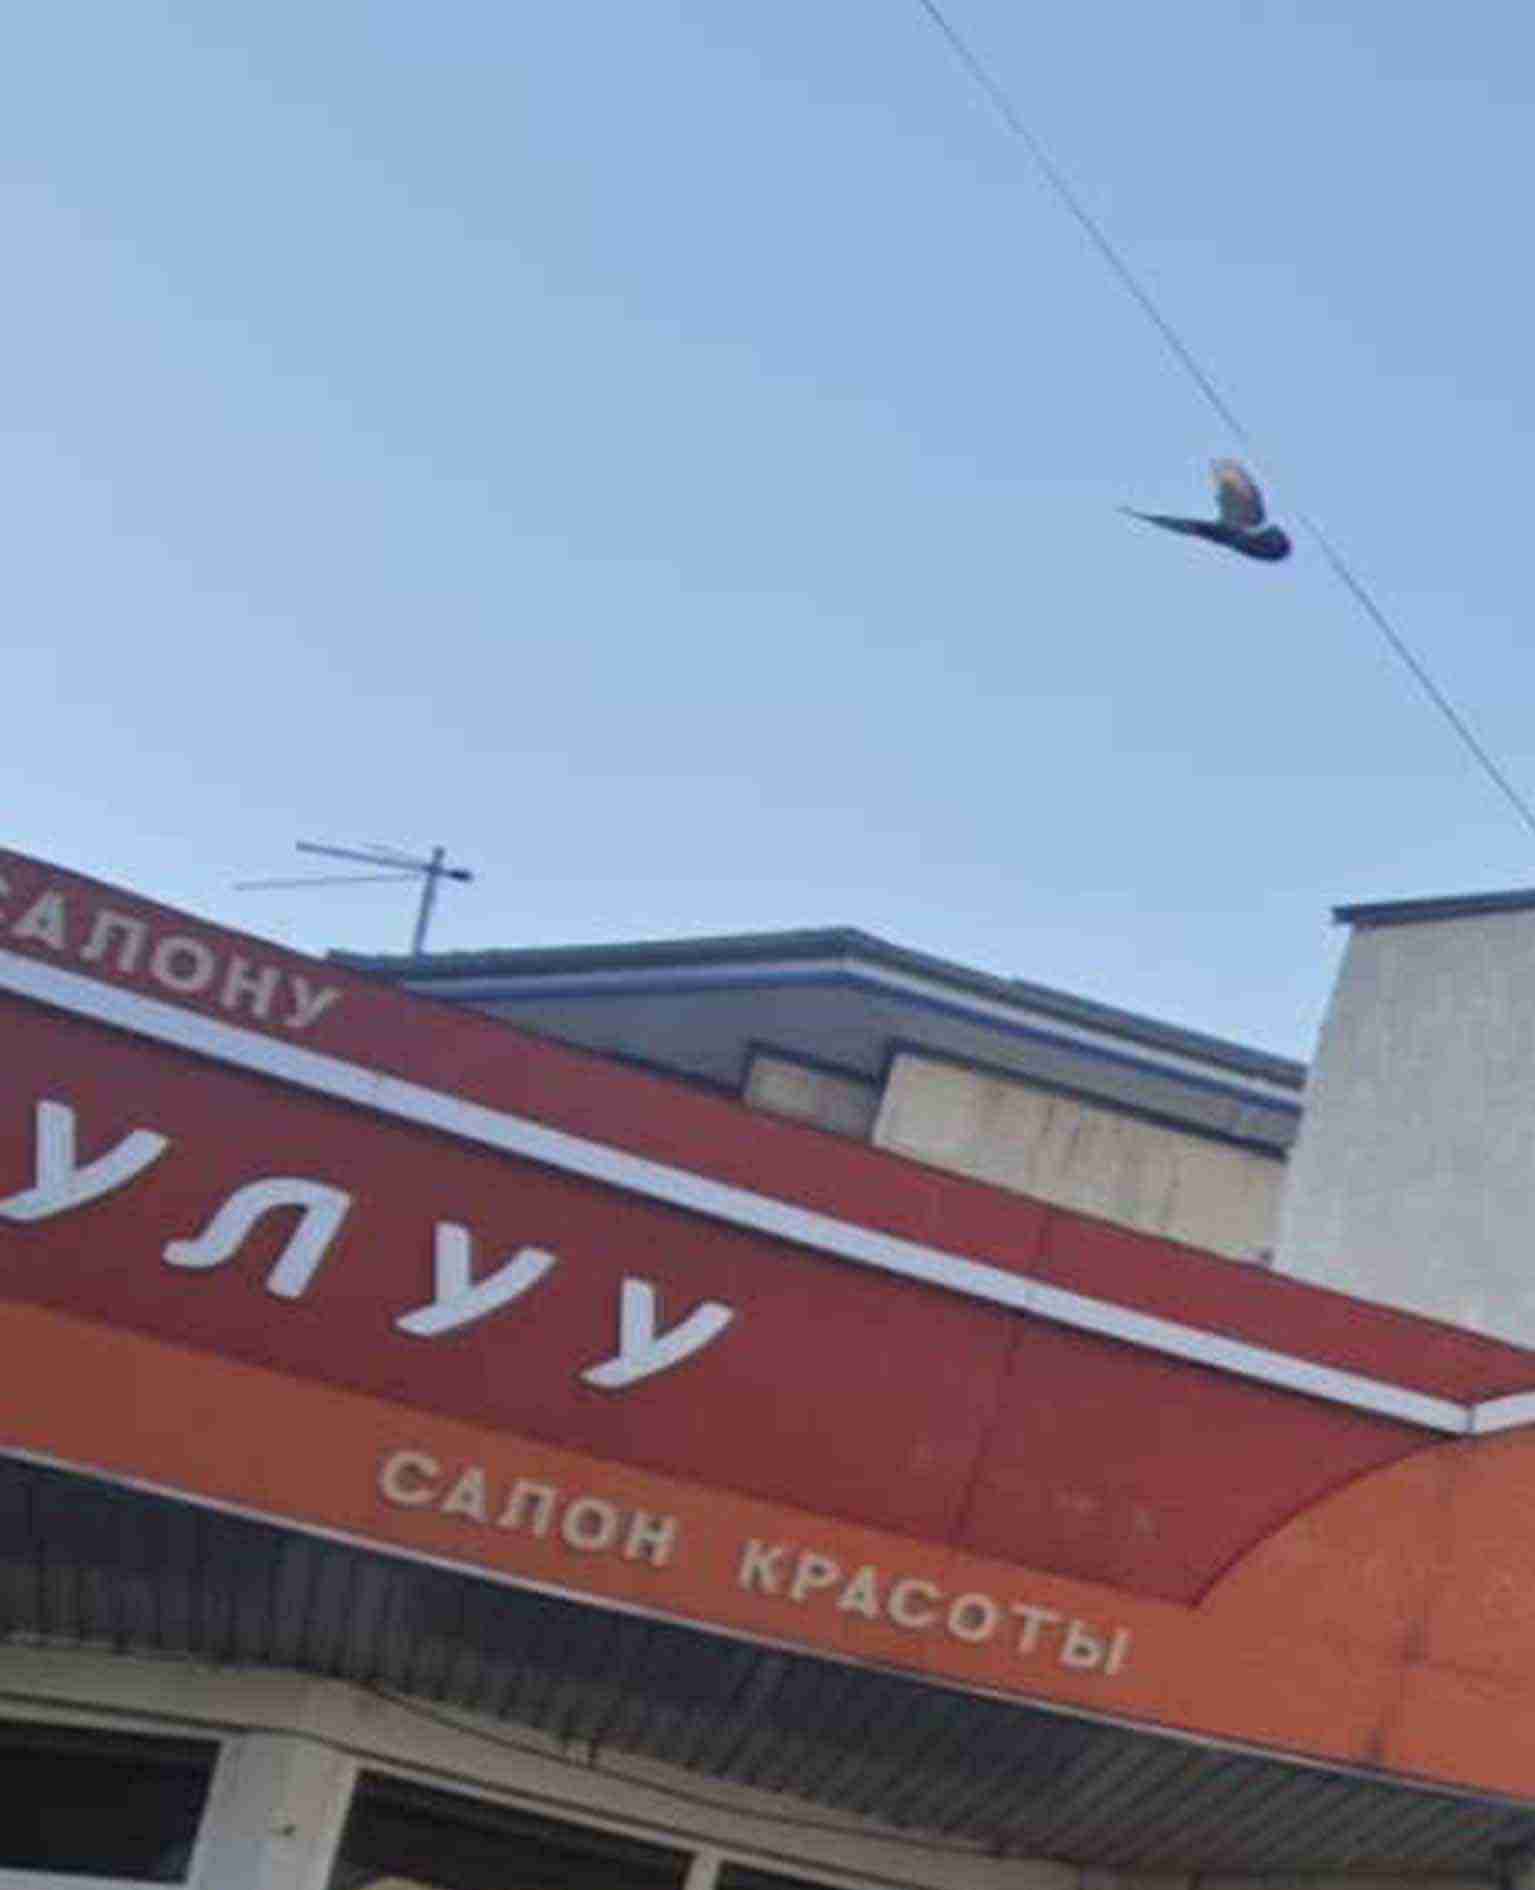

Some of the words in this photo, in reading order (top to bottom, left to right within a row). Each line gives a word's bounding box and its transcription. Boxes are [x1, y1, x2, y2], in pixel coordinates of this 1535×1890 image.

[0, 868, 343, 1029] АЛОНУ
[378, 1449, 680, 1568] САЛОН
[736, 1540, 1134, 1677] КРАСОТЫ
